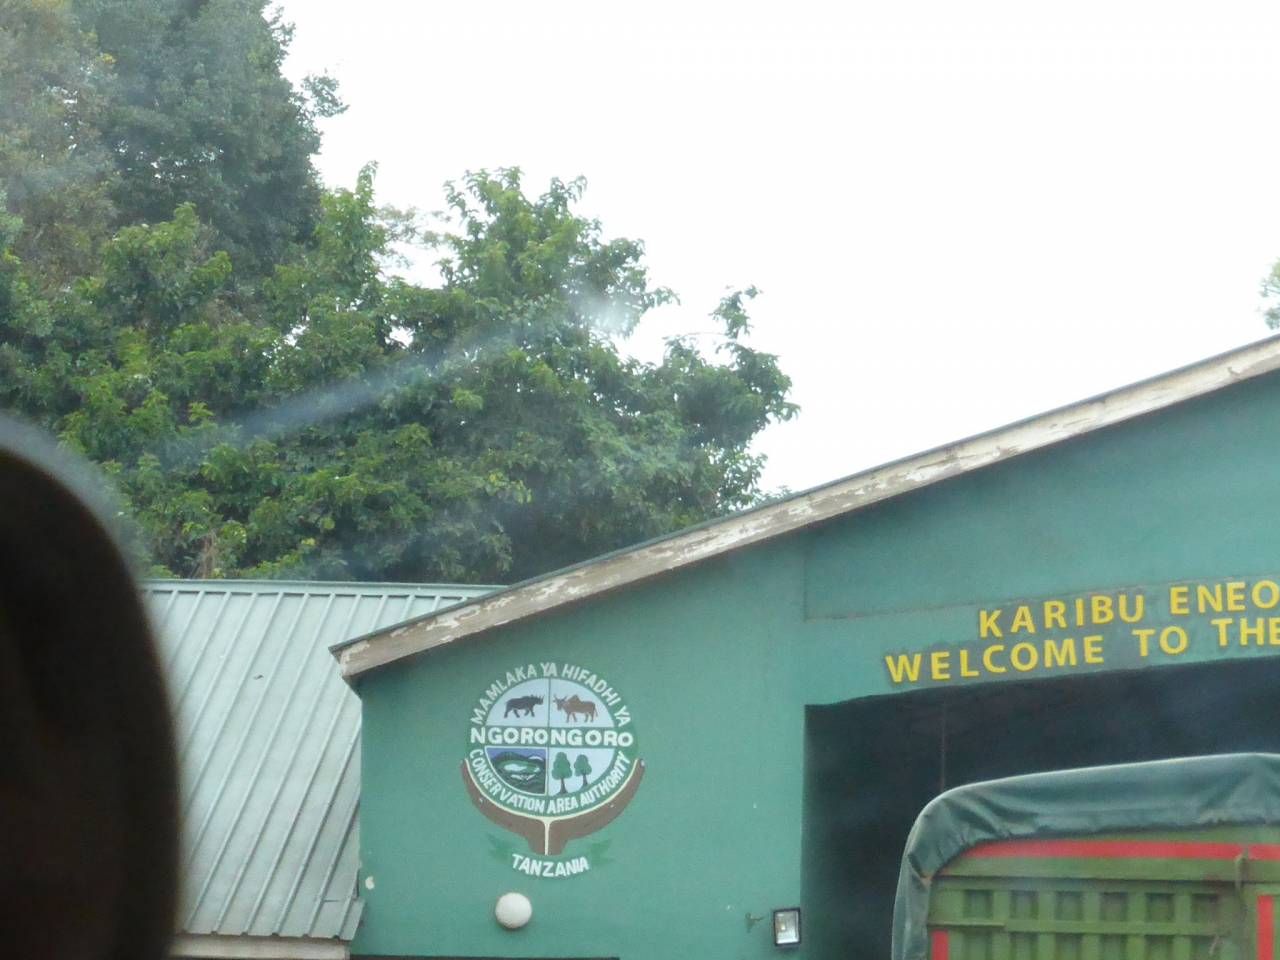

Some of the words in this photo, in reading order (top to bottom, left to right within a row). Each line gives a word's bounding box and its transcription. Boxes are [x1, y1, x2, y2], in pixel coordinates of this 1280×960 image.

[978, 594, 1146, 640] KARIBU
[885, 634, 1105, 684] WELCOME
[1132, 625, 1189, 658] TO
[470, 664, 537, 726] MAMLAKA
[540, 662, 558, 677] YA
[562, 663, 621, 707] HIFADHI
[614, 705, 632, 727] YA
[470, 727, 633, 747] NGORONGORO
[469, 748, 545, 813] CONSERVATION
[547, 797, 578, 815] AREA
[580, 750, 631, 807] AUTHORITY
[512, 853, 589, 878] TANZANIA
